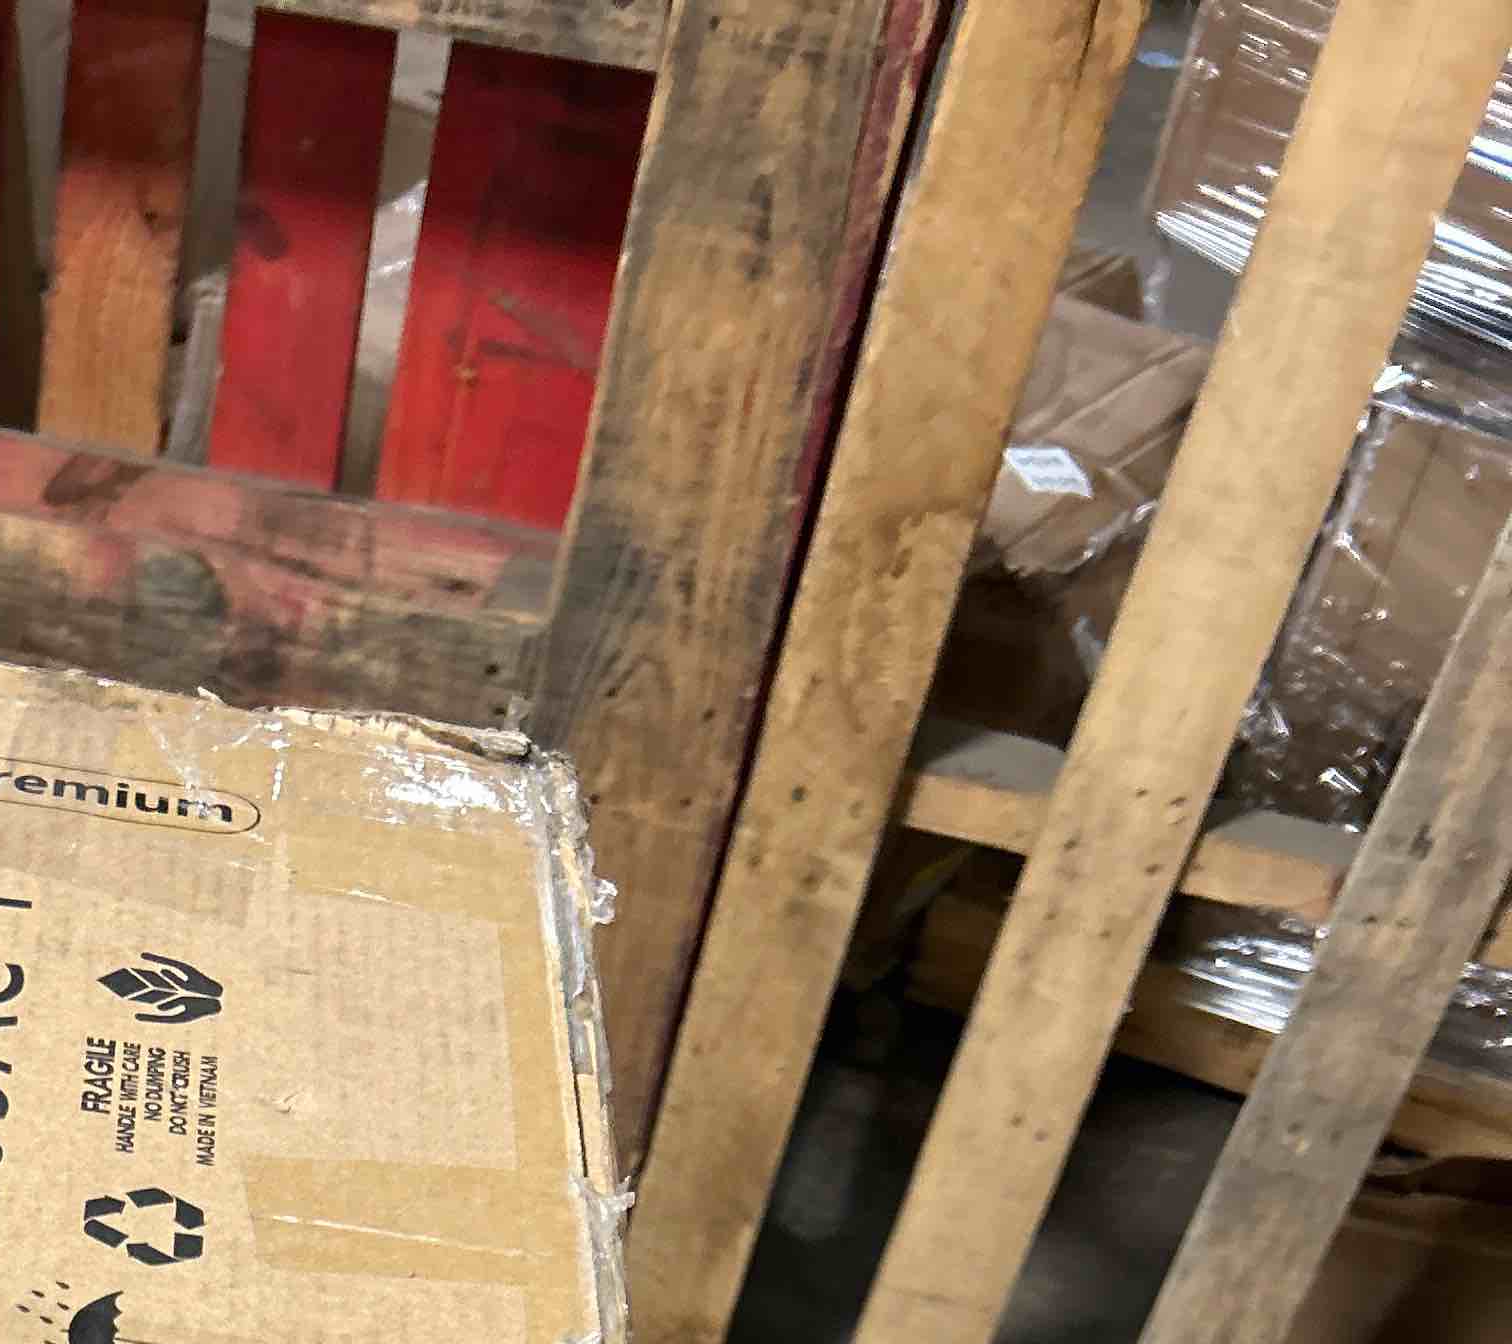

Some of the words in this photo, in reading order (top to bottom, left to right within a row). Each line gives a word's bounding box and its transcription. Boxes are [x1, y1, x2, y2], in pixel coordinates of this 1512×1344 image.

[80, 1036, 116, 1115] FRAGILE
[122, 1042, 141, 1072] CARE
[146, 1048, 166, 1100] DUMPING
[172, 1051, 190, 1089] CRUSH
[120, 1074, 138, 1101] WITH
[200, 1056, 218, 1108] VIETNAM
[116, 1105, 136, 1153] HANDLE
[144, 1102, 162, 1121] NO
[169, 1116, 186, 1135] DO
[198, 1114, 216, 1127] IN
[197, 1129, 215, 1166] MADE
